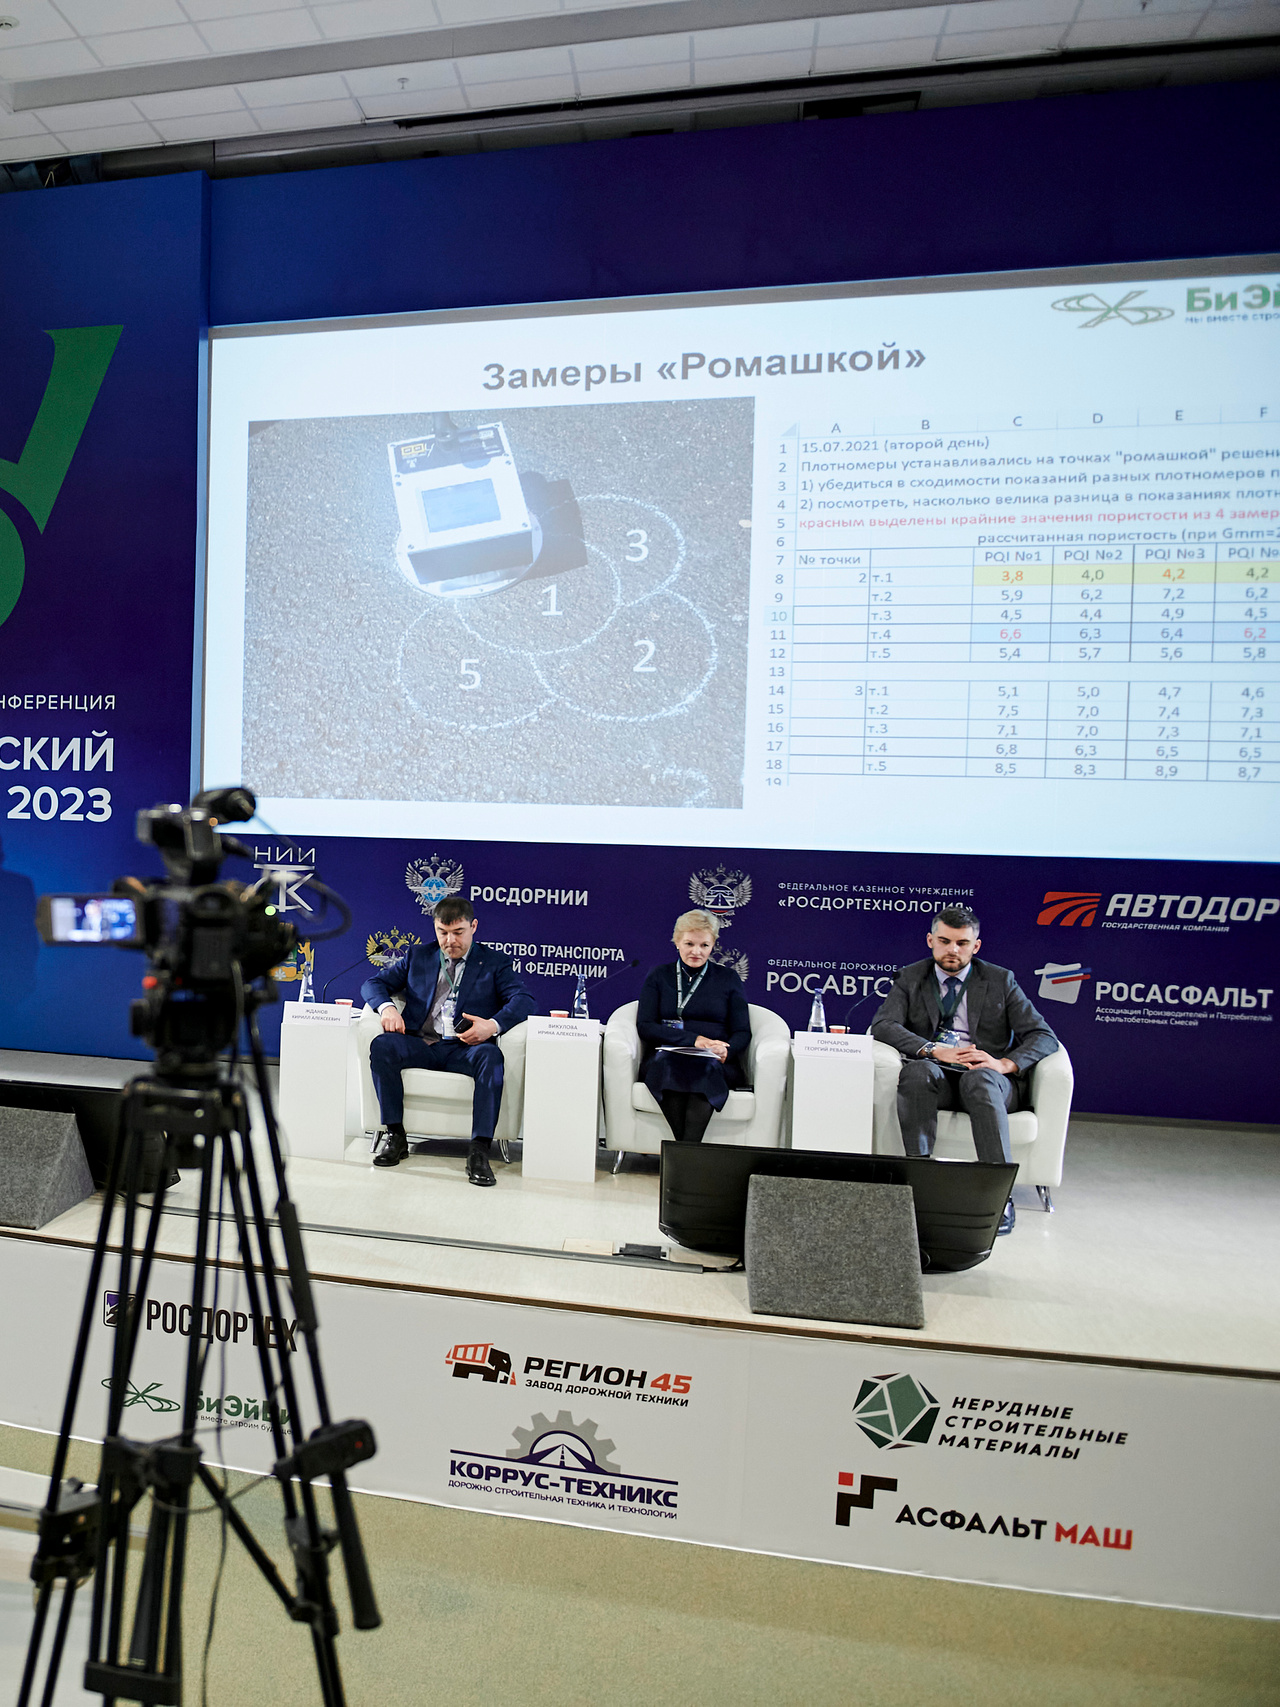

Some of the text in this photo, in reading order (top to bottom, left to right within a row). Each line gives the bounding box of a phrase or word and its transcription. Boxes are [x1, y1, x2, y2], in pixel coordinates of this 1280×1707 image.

[482, 341, 927, 391] Замеры «Ромашкой»
[802, 436, 990, 454] 15.07.2021 (второй день)
[801, 448, 1216, 472] Плотномеры устанавливались на точках "ромашкой"
[801, 469, 1265, 492] 1) убедиться сходимости показаний разных плотномеров
[800, 489, 1231, 511] 2) посмотреть, насколько велика разница показаниях
[799, 508, 1224, 529] красным выделены крайние значения пористости из 4
[625, 529, 650, 562] 3
[977, 527, 1217, 546] рассчитанная пористость (при
[798, 547, 1255, 565] № точки PQI №1 PQI №2 PQI №3 PQI
[872, 567, 1269, 584] т.1 3,8 4,0 4,2 4,2
[541, 584, 563, 616] 1
[872, 587, 1268, 603] т.2 5,9 6,2 7,2 6,2
[871, 608, 1268, 622] т.3 4,5 4,4 4,9 4,5
[870, 627, 1267, 642] т.4 6,6 6,3 6,4 6,2
[633, 639, 657, 672] 2
[870, 647, 1266, 661] т.5 5,4 5,7 5,6 5,8
[458, 658, 481, 690] 5
[868, 685, 1265, 700] т.1 5,1 5,0 4,7 4,6
[868, 704, 1263, 720] т.2 7,5 7,0 7,4 7,3
[867, 723, 1262, 740] т.3 7,1 7,0 7,3 7,1
[867, 742, 1262, 760] т.4 6,8 6,3 6,5 6,5
[866, 761, 1261, 780] т.5 8,5 8,3 8,9 8,7
[7, 785, 112, 822] 2023
[254, 846, 315, 863] НИИ
[470, 885, 588, 906] РОСДОРНИИ
[778, 882, 974, 897] ФЕДЕРАЛЬНОЕ КАЗЕННОЕ УЧРЕЖДЕНИЕ
[1105, 893, 1280, 923] АВТОДОР
[1101, 922, 1181, 931] ГОСУДАРСТВЕННАЯ
[540, 944, 625, 962] ТРАНСПОРТА
[525, 961, 607, 979] ФЕДЕРАЦИИ
[767, 958, 837, 970] ФЕДЕРАЛЬНОЕ
[839, 961, 898, 972] ДОРОЖНОЕ
[1095, 981, 1274, 1009] РОСАСФАЛЬТ
[1095, 1006, 1273, 1022] Ассоциация Производителей Потребителей
[1095, 1015, 1199, 1026] Асфальтобетонных Смесей
[523, 1356, 693, 1395] РЕГИОН 45
[525, 1379, 689, 1408] ЗАВОД ДОРОЖНОЙ ТЕХНИКИ
[951, 1396, 1074, 1420] НЕРУДНЫЕ
[200, 1415, 259, 1430] вместе строим
[945, 1415, 1129, 1445] СТРОИТЕЛЬНЫЕ
[938, 1433, 1081, 1460] МАТЕРИАЛЫ
[450, 1459, 678, 1509] КОРРУС-ТЕХНИКС
[448, 1479, 678, 1520] ДОРОЖНО СТРОИТЕЛЬНАЯ ТЕХНИКА ТЕХНОЛОГИИ
[894, 1504, 1133, 1551] АСФАЛЬТ МАШ
